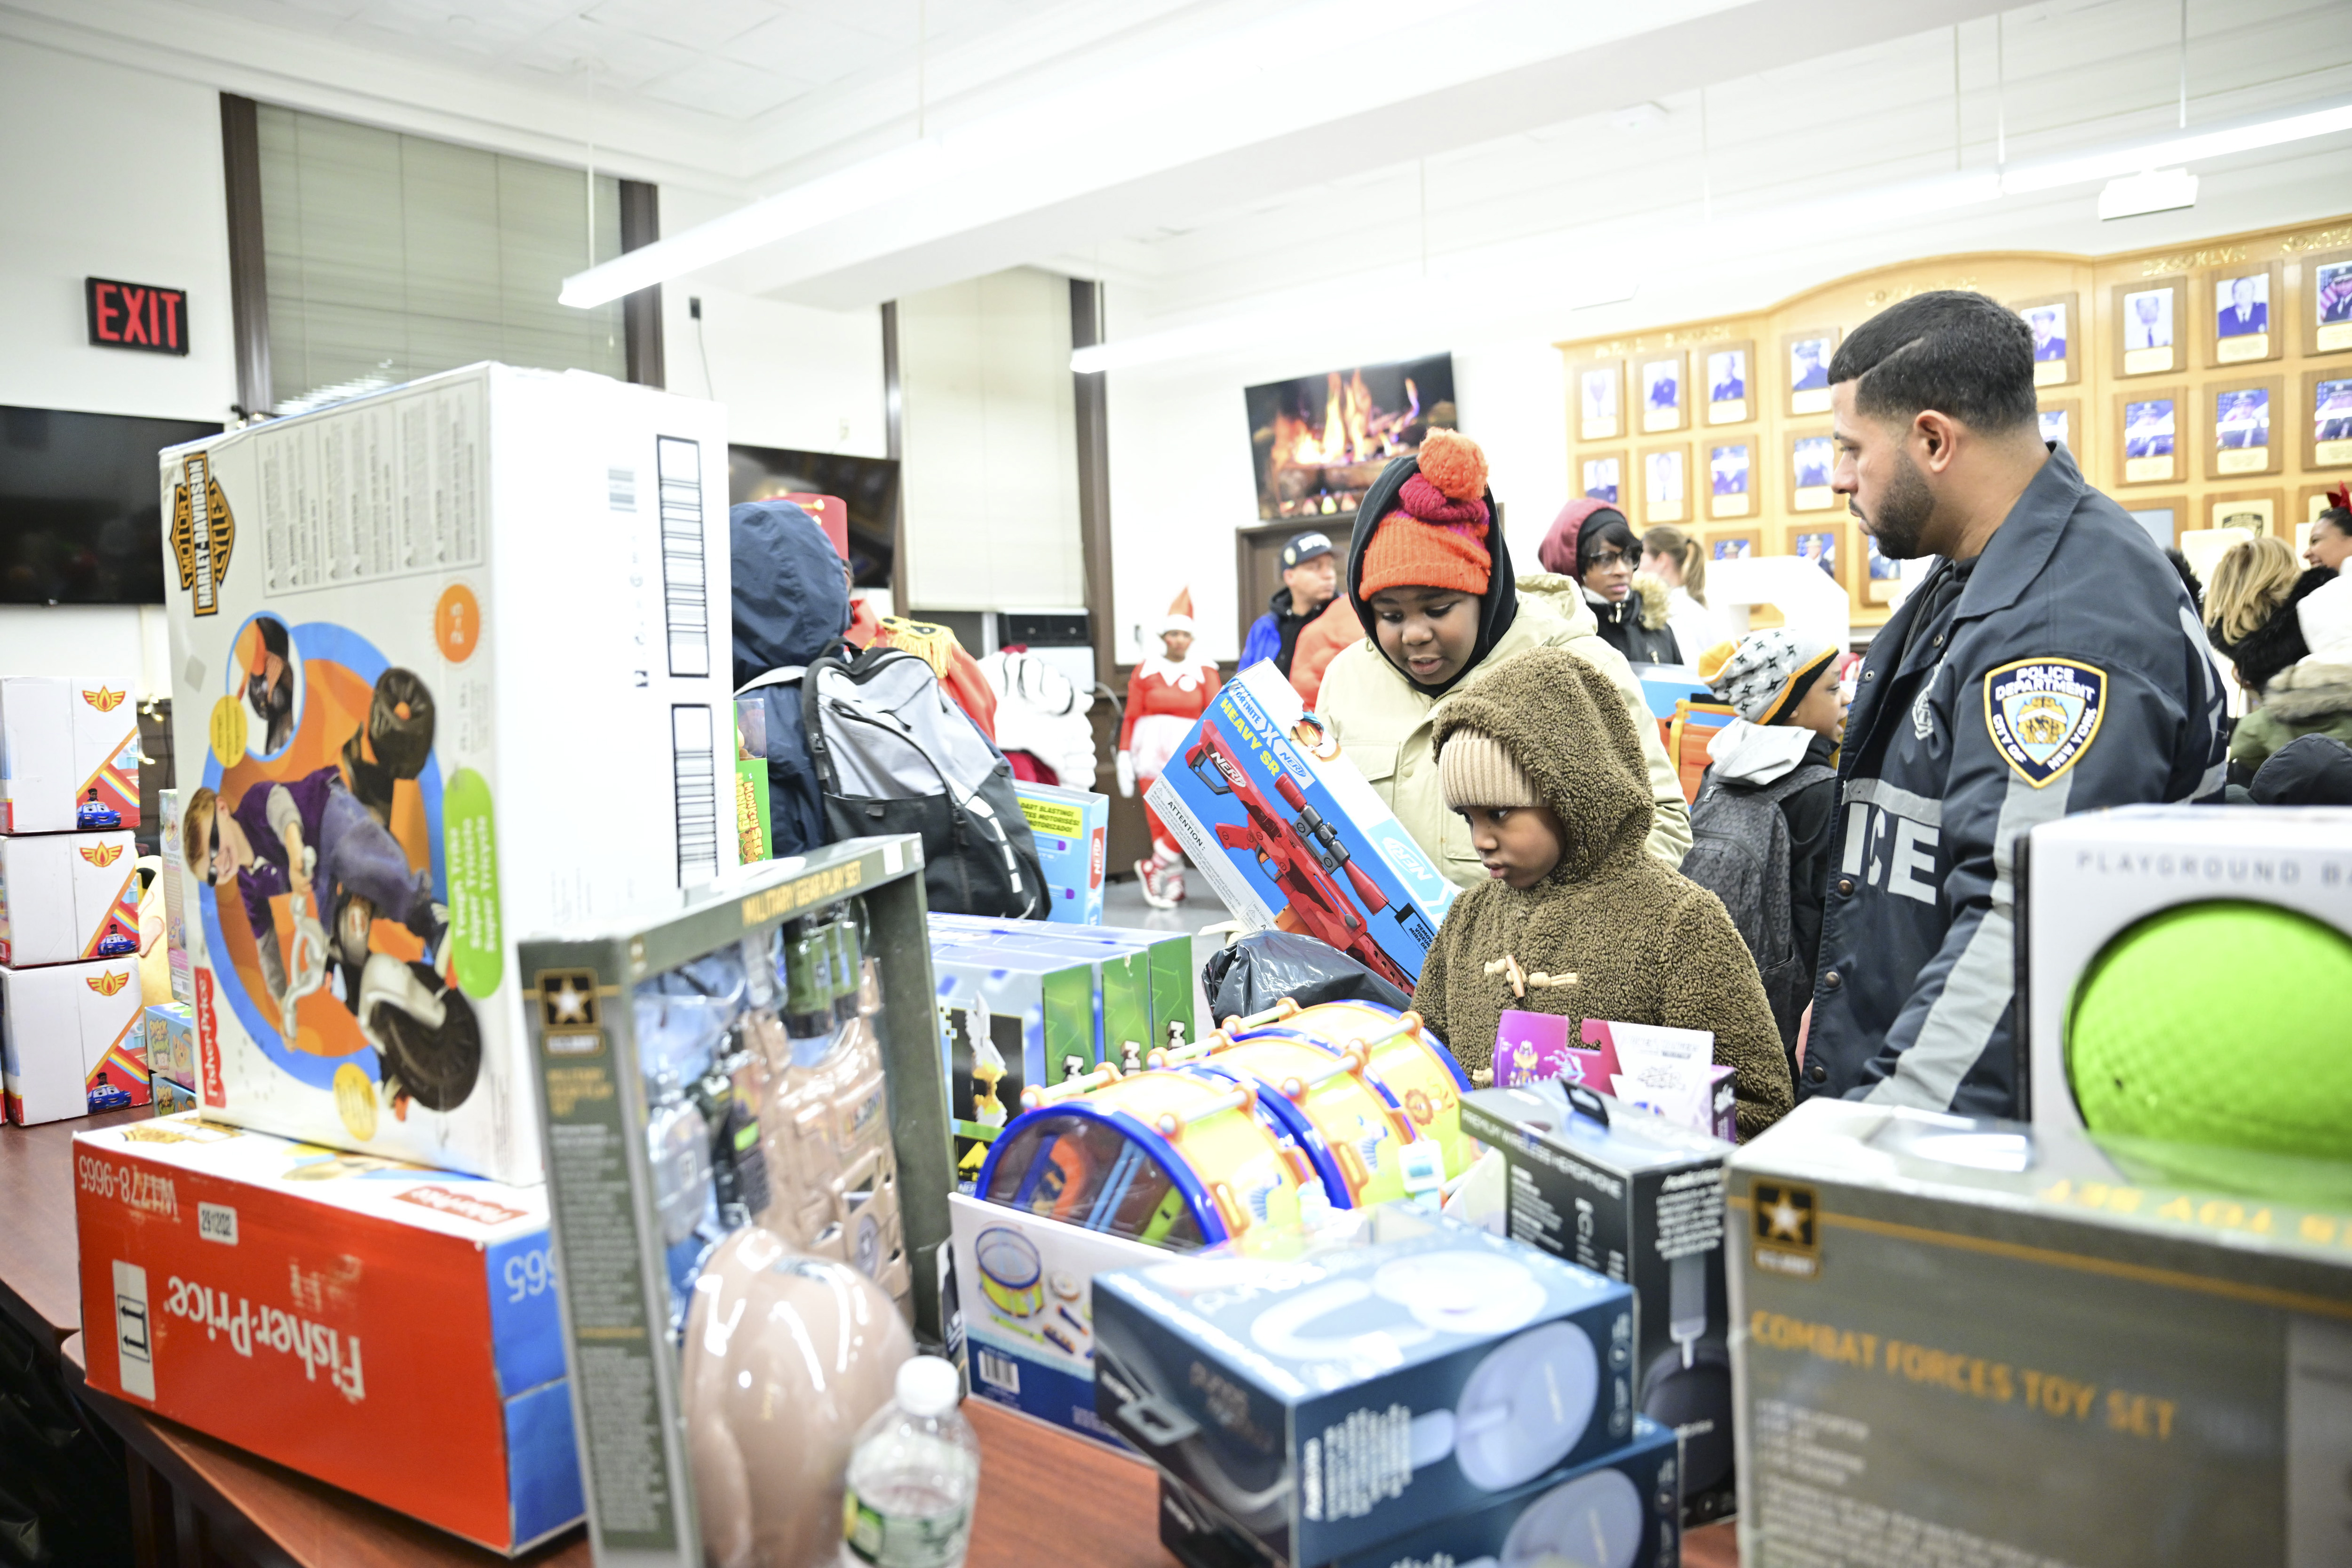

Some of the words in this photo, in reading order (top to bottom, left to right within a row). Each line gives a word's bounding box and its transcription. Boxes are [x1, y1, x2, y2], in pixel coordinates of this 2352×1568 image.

[95, 282, 181, 349] EXIT
[176, 499, 193, 574] MOTOR
[189, 459, 214, 608] HARLEY-DAVIDSON
[1995, 679, 2095, 701] DEPARTMENT
[2016, 666, 2074, 682] POLICE
[1220, 698, 1263, 750] HEAVY
[1260, 750, 1280, 777] SR
[1260, 723, 1280, 748] X
[1279, 752, 1306, 777] NERF
[1993, 714, 2013, 745] CITY
[2047, 742, 2075, 771] NEW
[2070, 708, 2098, 744] YORK
[1210, 751, 1247, 788] NERF
[2007, 744, 2027, 763] OF
[1167, 801, 1203, 846] ATTENTION
[1382, 837, 1434, 881] NERF
[2075, 849, 2302, 887] PLAYGROUND
[1408, 927, 1422, 942] MIRA
[1414, 927, 1431, 948] VISEUR
[168, 1275, 366, 1400] Fisher-Price
[1751, 1310, 1878, 1369] COMBAT
[1885, 1339, 2013, 1403] FORCES
[2021, 1368, 2096, 1422] TOY
[2106, 1387, 2177, 1442] SET
